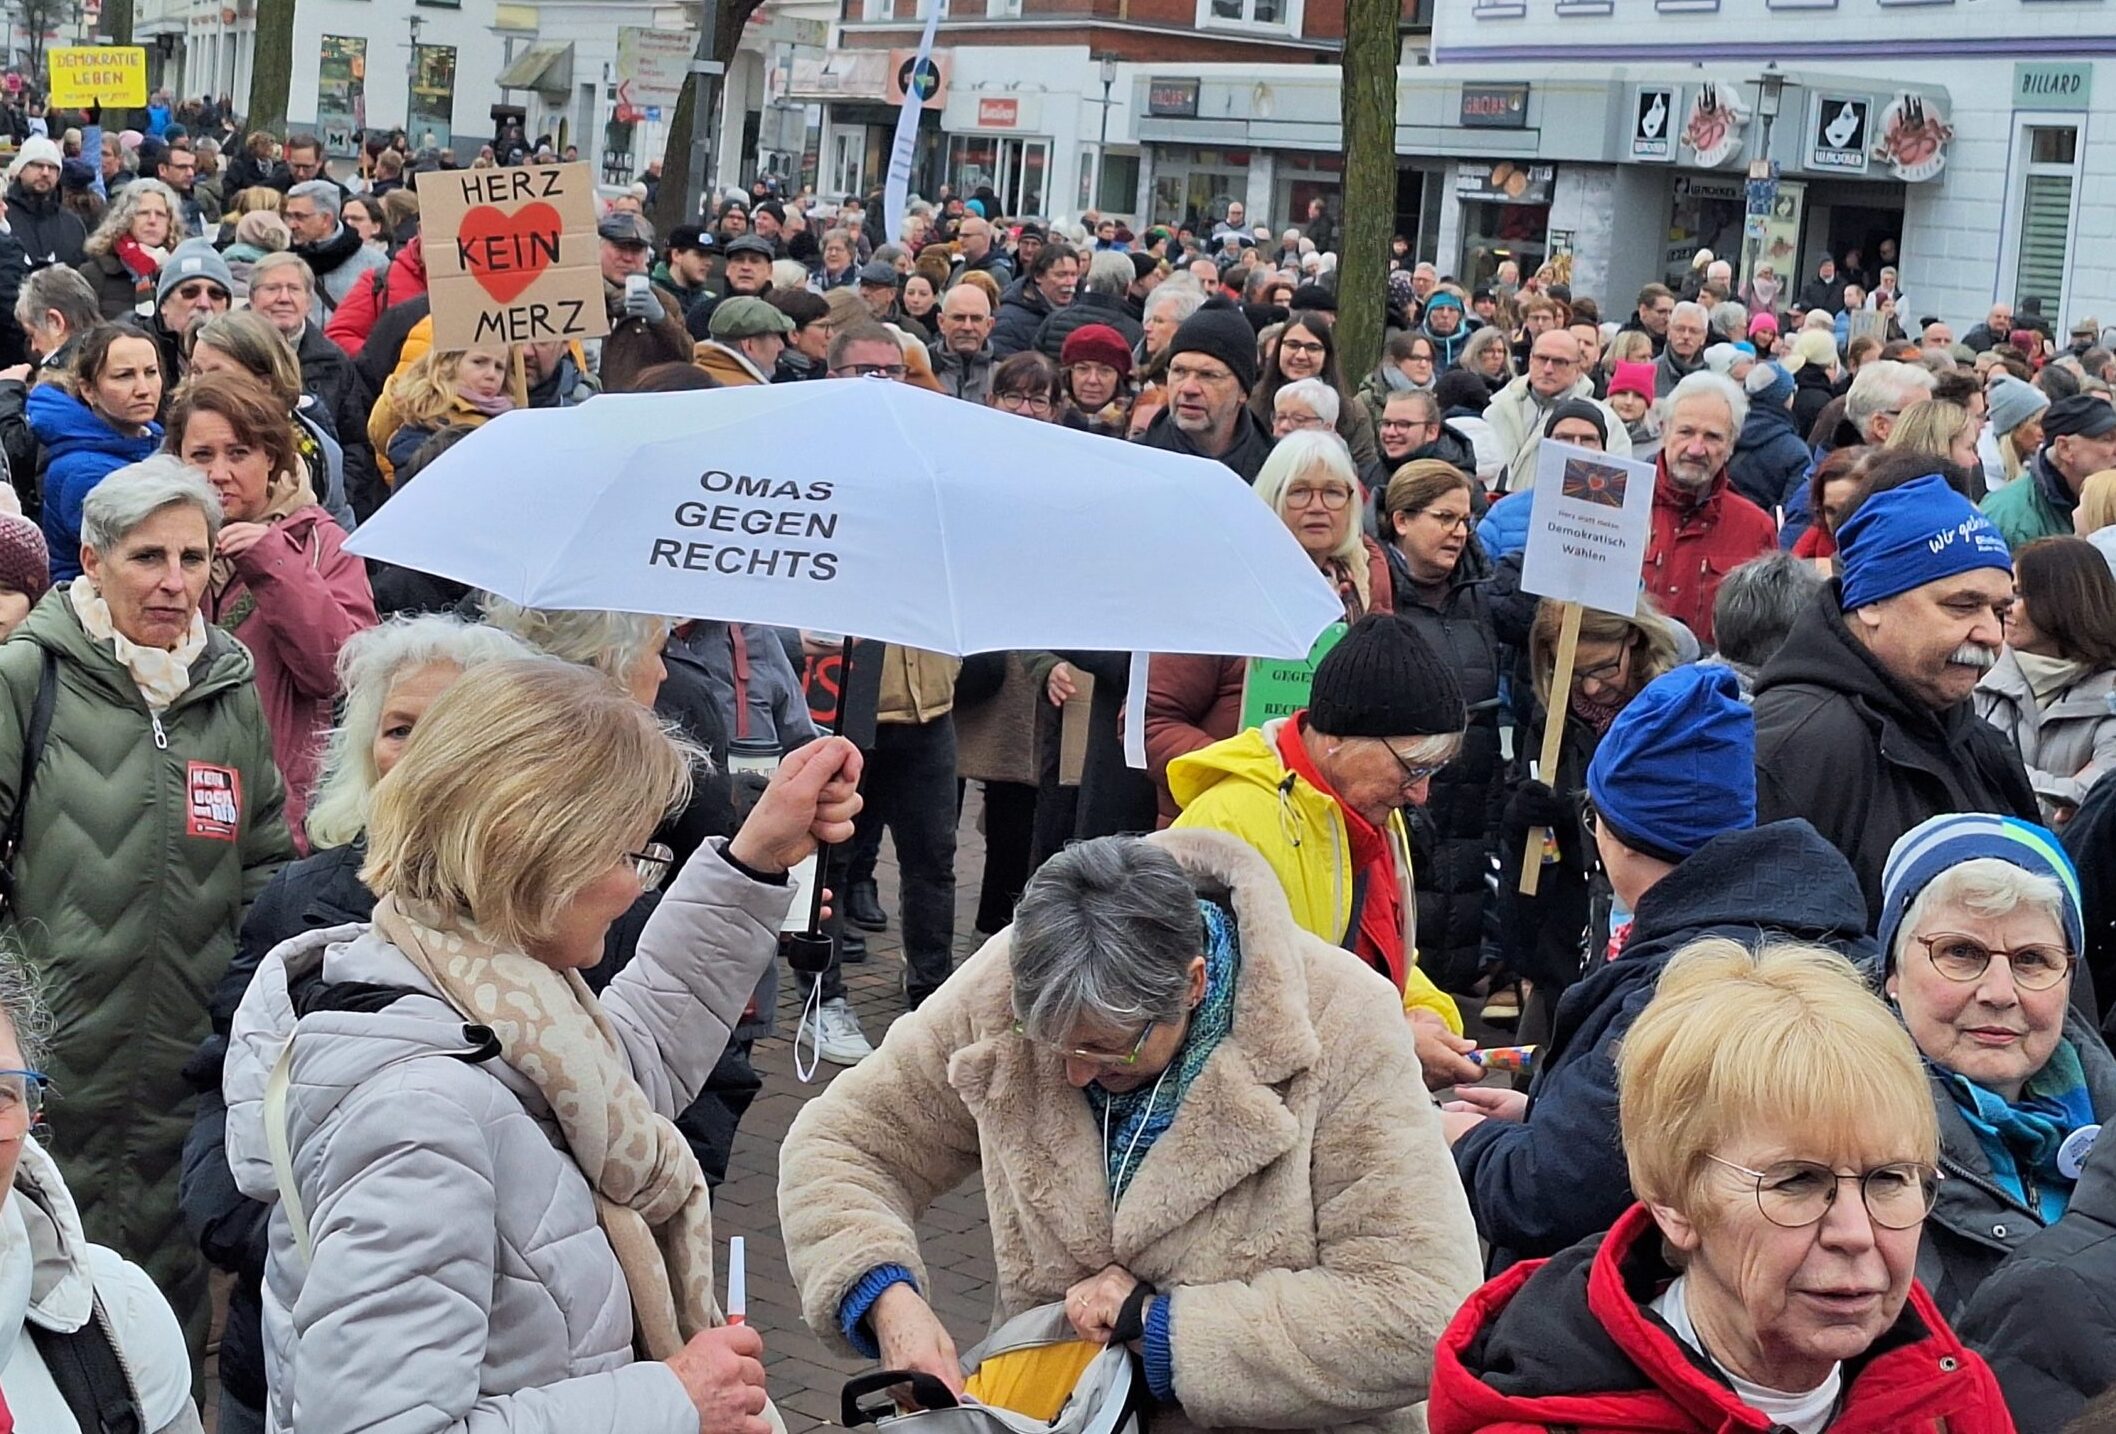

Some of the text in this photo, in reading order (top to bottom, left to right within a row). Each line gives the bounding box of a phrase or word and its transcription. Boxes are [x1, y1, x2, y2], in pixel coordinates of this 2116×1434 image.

[56, 51, 138, 67] DEMOKRATIE
[73, 71, 123, 85] LEBEN
[2022, 73, 2080, 94] BILLARD
[329, 132, 343, 146] M
[461, 170, 564, 205] HERZ
[457, 231, 560, 271] KEIN
[474, 300, 586, 343] MERZ
[700, 470, 835, 501] OMAS
[674, 501, 839, 539] GEGEN
[1548, 521, 1627, 550] Demokratisch
[649, 538, 839, 581] RECHTS
